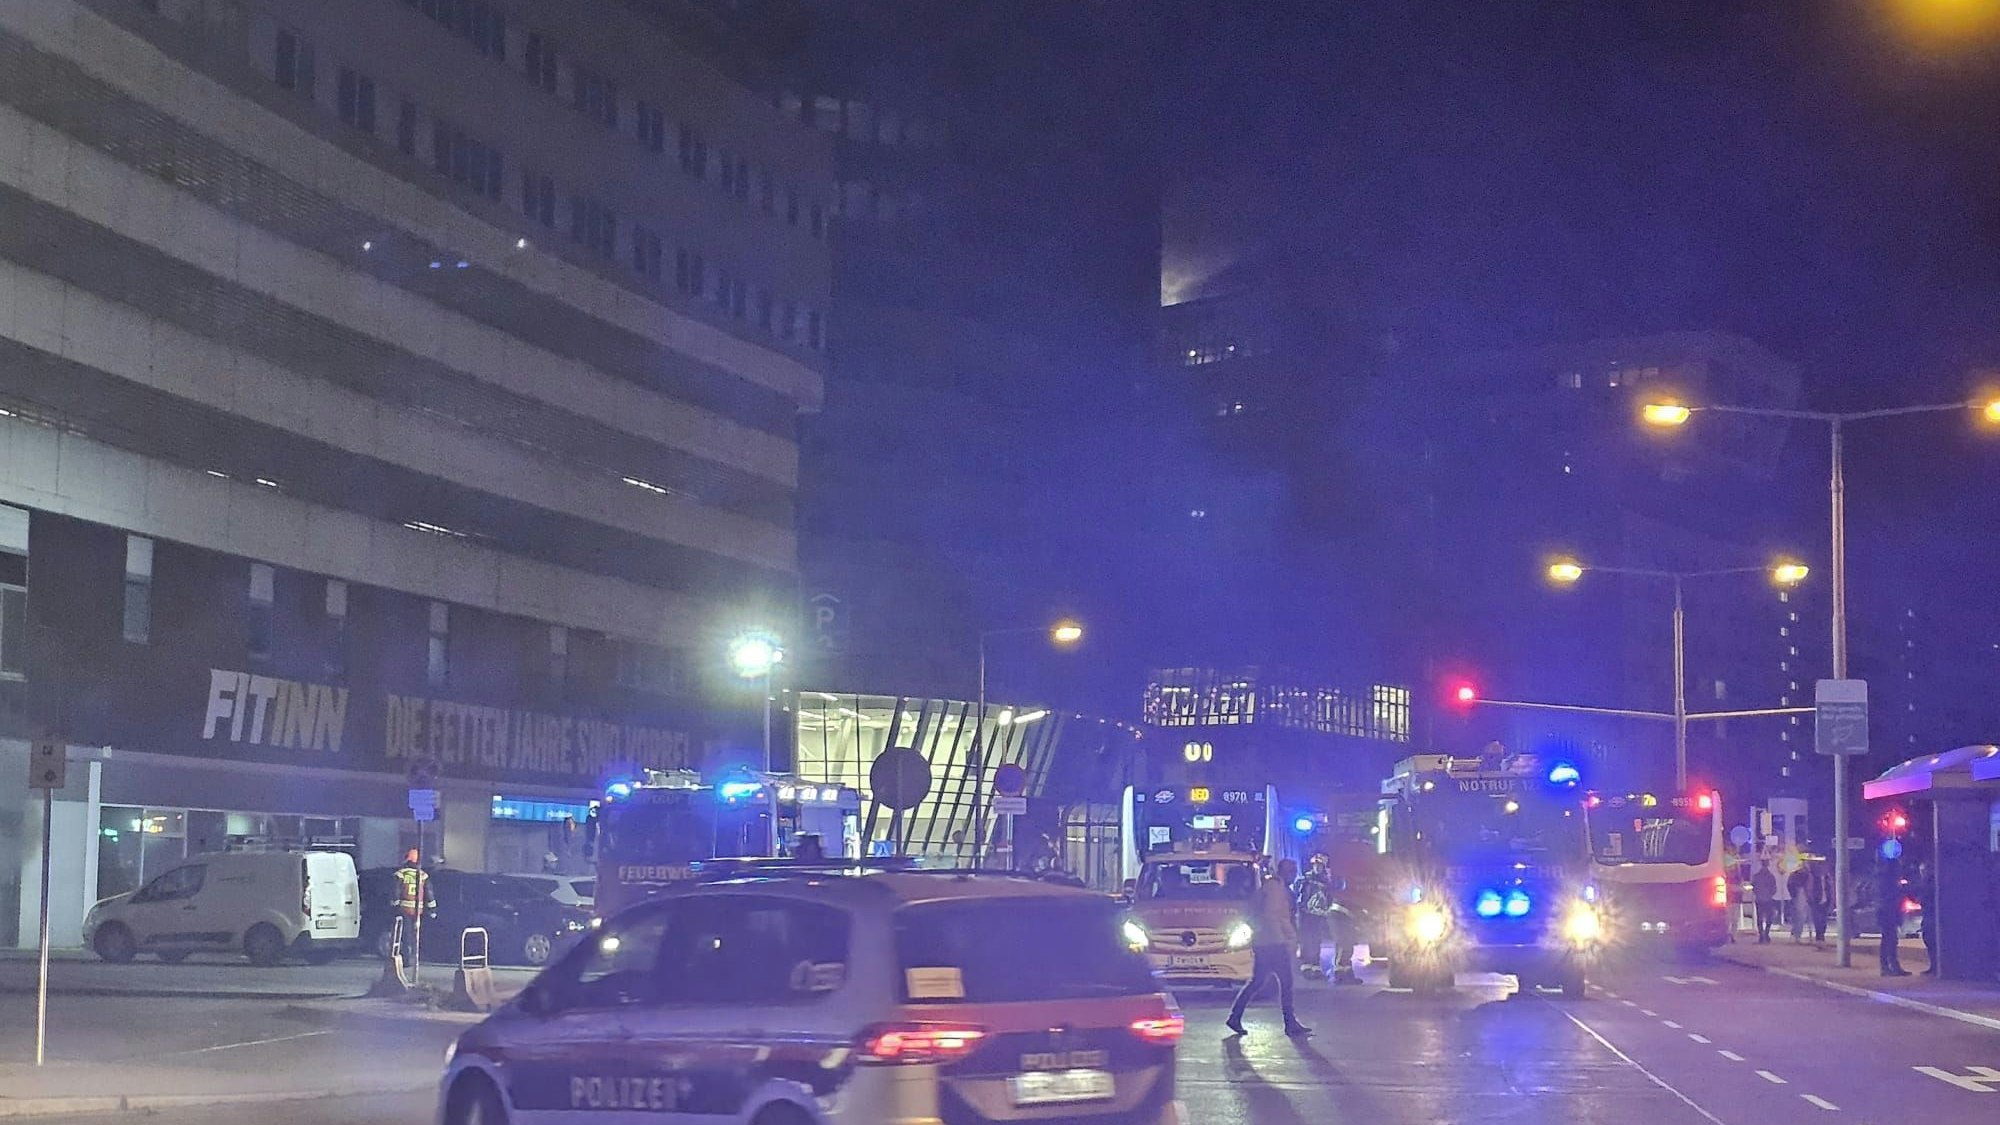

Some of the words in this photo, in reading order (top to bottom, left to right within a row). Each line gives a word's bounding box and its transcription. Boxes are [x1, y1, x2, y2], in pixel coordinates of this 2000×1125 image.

[203, 668, 349, 752] FITINN
[385, 694, 425, 758] DIE
[1459, 780, 1515, 792] NOTRUF
